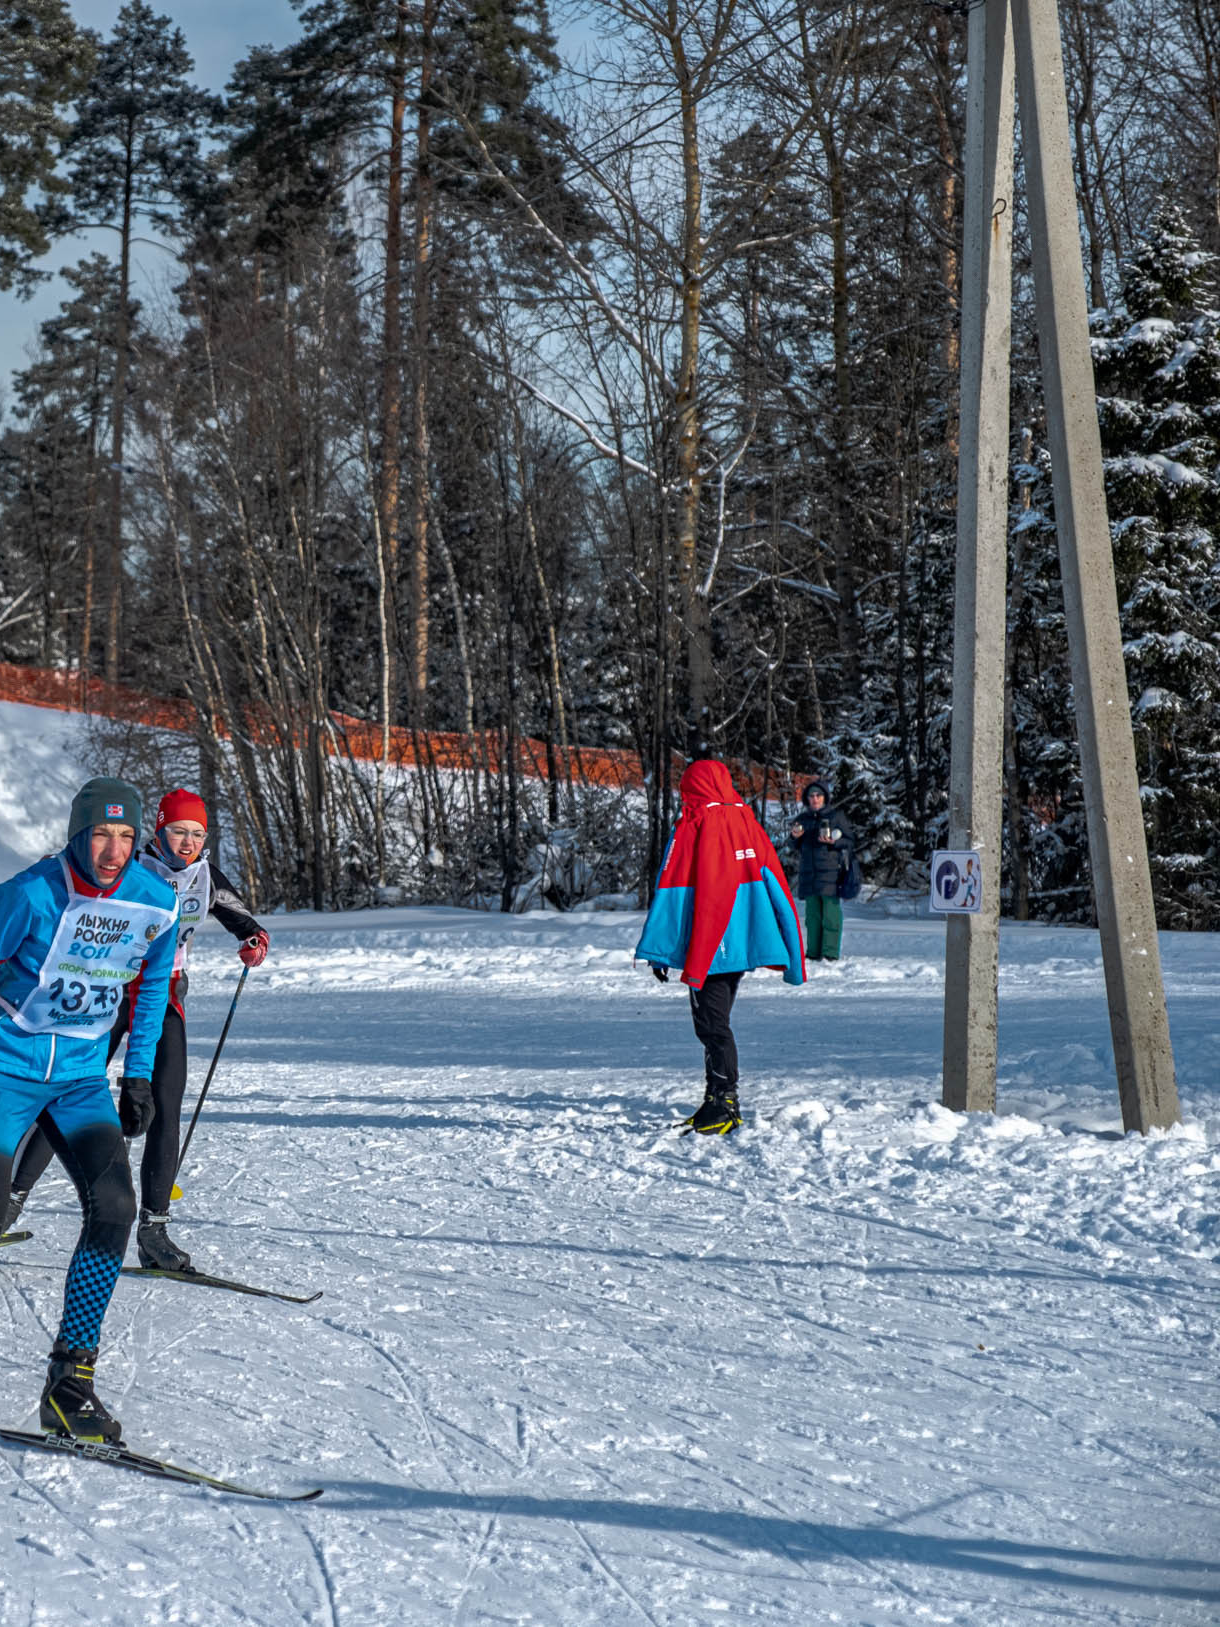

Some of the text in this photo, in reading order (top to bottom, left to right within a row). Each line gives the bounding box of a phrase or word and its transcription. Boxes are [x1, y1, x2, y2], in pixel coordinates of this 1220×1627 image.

[76, 913, 131, 932] ЛЫЖНЯ
[73, 927, 123, 945] РОССИИ
[68, 942, 112, 959] 2021
[45, 1433, 121, 1460] FISCHER
